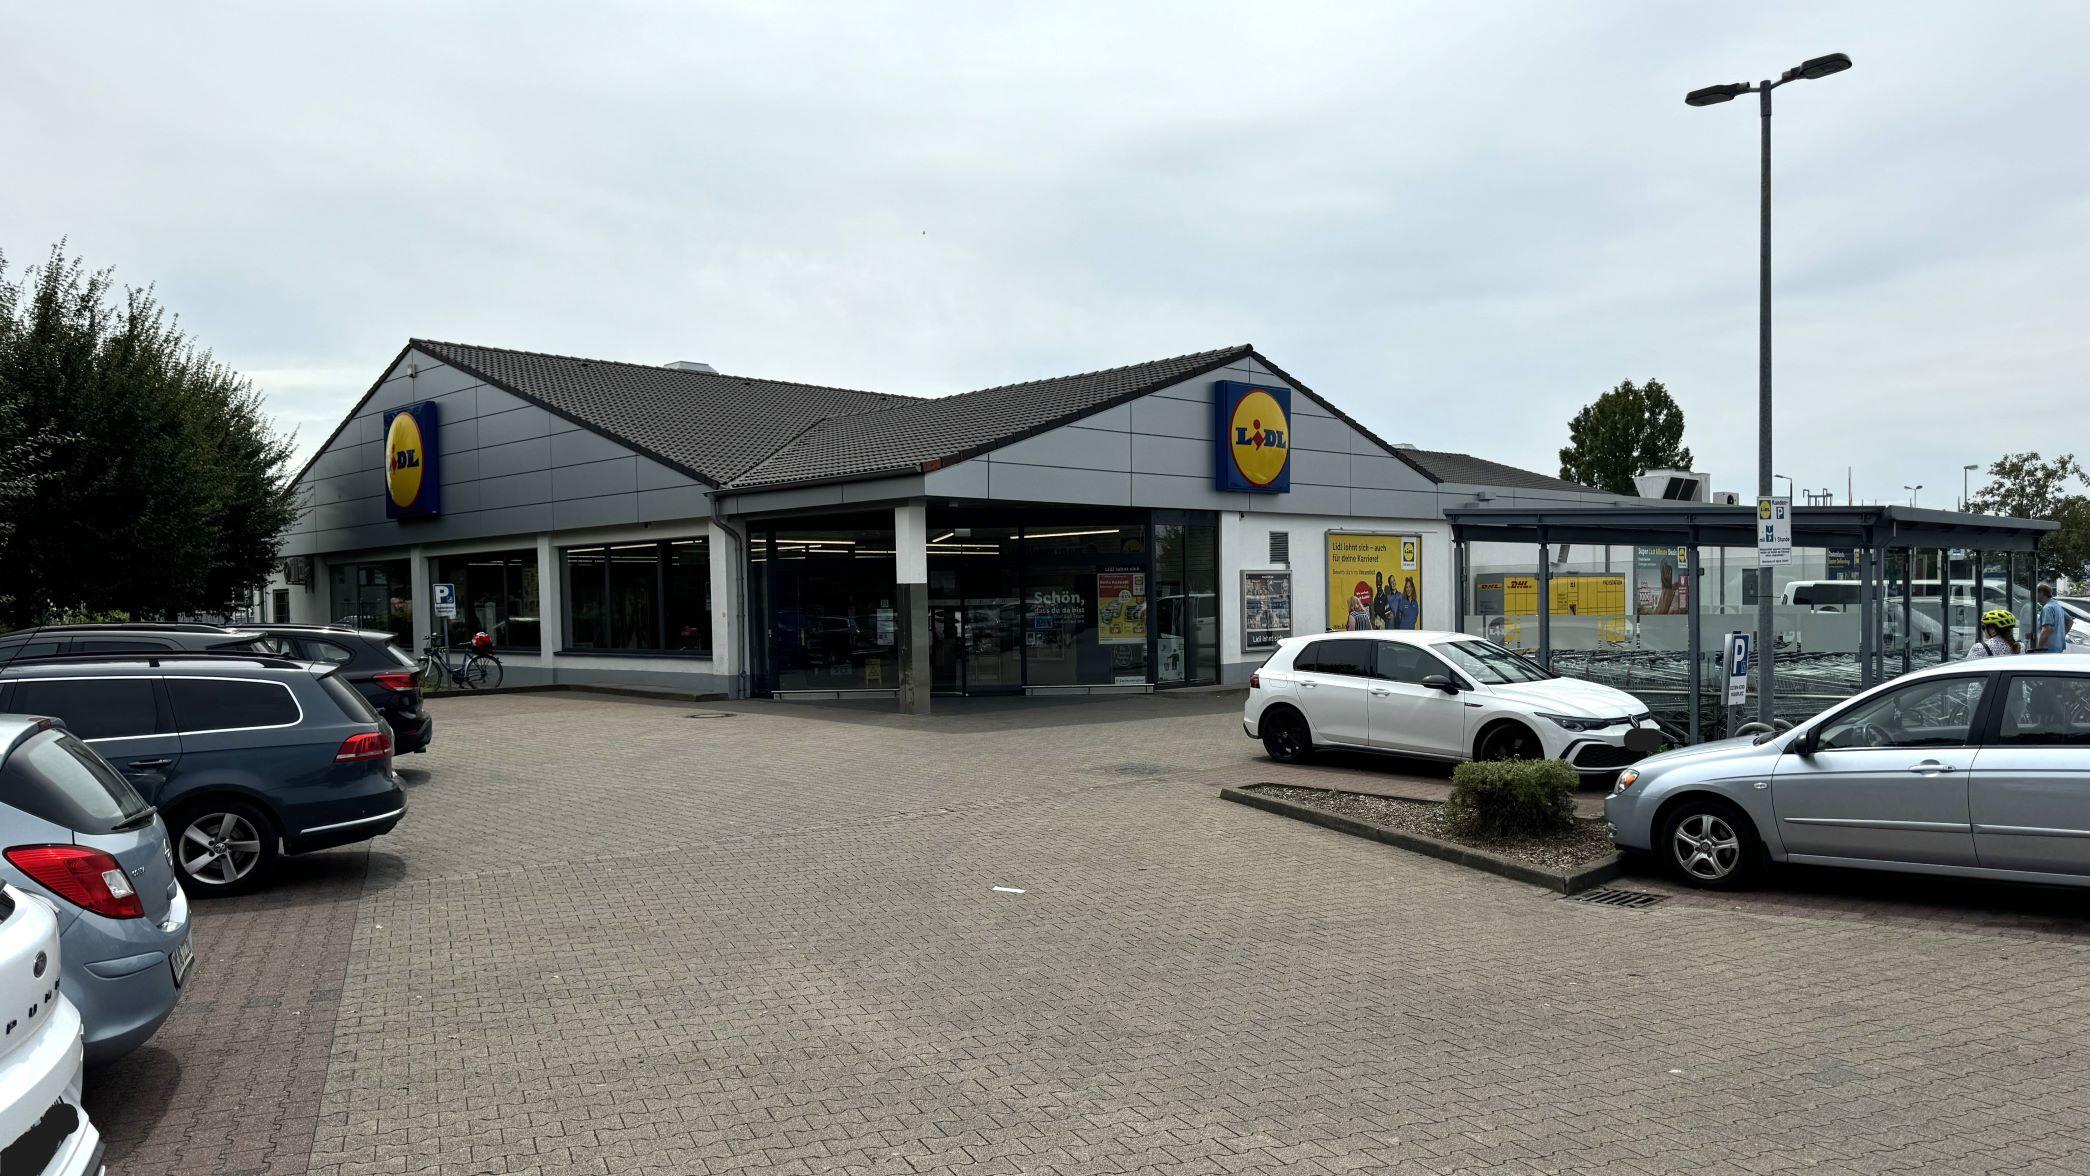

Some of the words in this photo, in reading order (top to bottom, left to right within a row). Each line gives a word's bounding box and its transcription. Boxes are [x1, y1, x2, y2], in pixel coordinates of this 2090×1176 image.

[1332, 542, 1342, 551] Lidl
[1343, 543, 1358, 552] lohnt
[1358, 544, 1370, 552] sich
[1374, 544, 1387, 552] auch
[1332, 553, 1341, 562] für
[1341, 555, 1357, 563] deine
[1357, 554, 1379, 563] Karriere!
[434, 585, 450, 604] P
[1034, 590, 1085, 606] Schön,
[1252, 635, 1262, 643] Lidl
[1732, 638, 1746, 674] P
